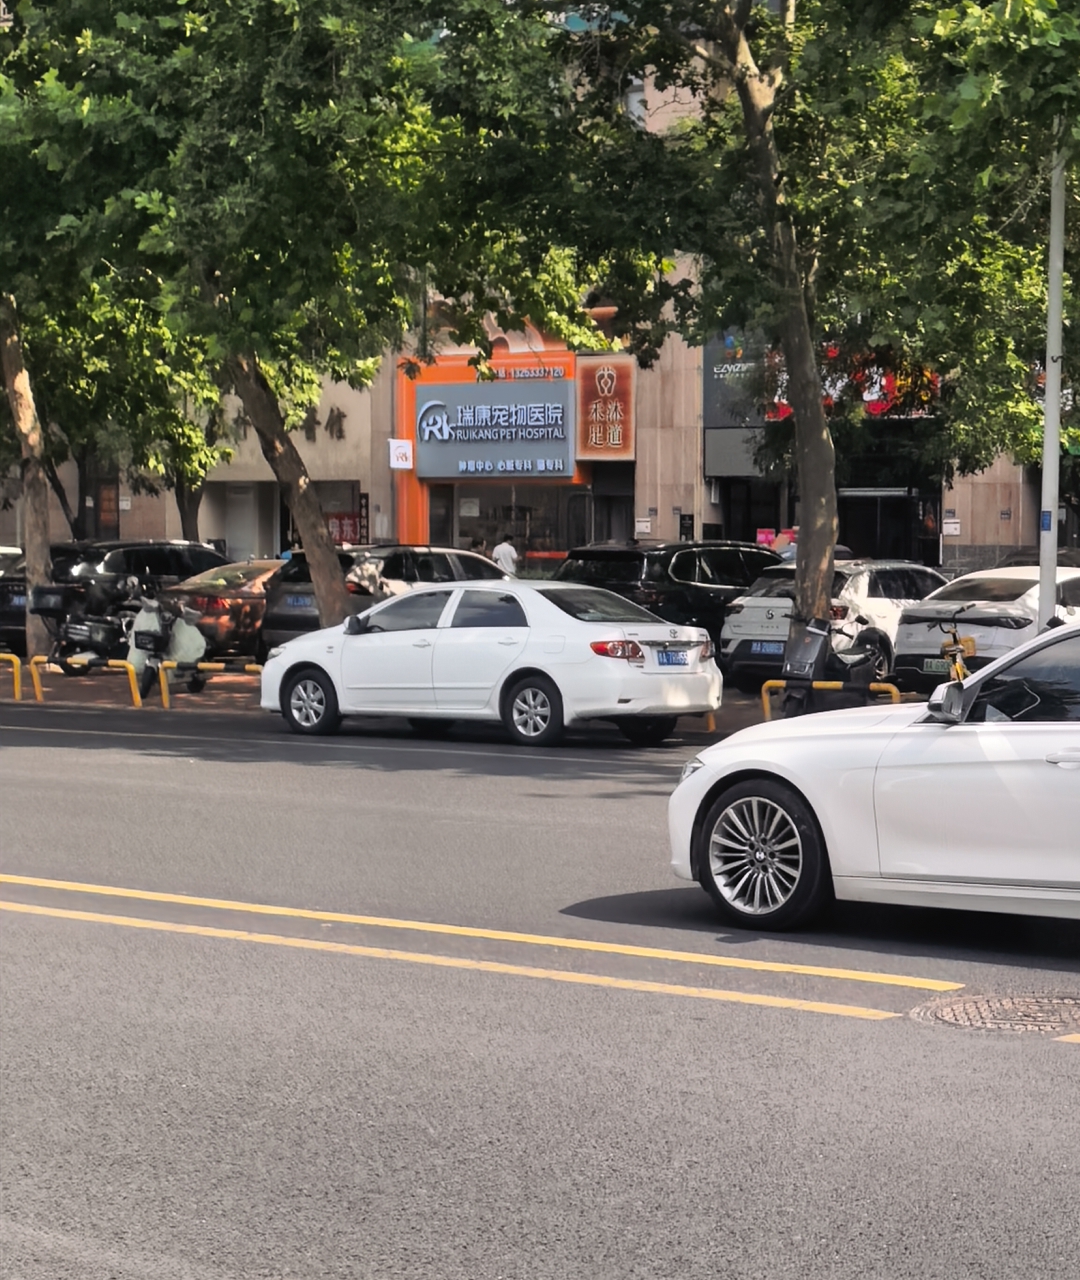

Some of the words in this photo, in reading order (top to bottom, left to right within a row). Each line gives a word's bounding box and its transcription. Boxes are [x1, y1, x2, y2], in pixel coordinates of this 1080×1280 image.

[457, 403, 563, 426] 瑞康宠物医院
[457, 428, 498, 440] RUIKANG
[500, 428, 516, 439] PET
[519, 427, 565, 439] HOSPITAL
